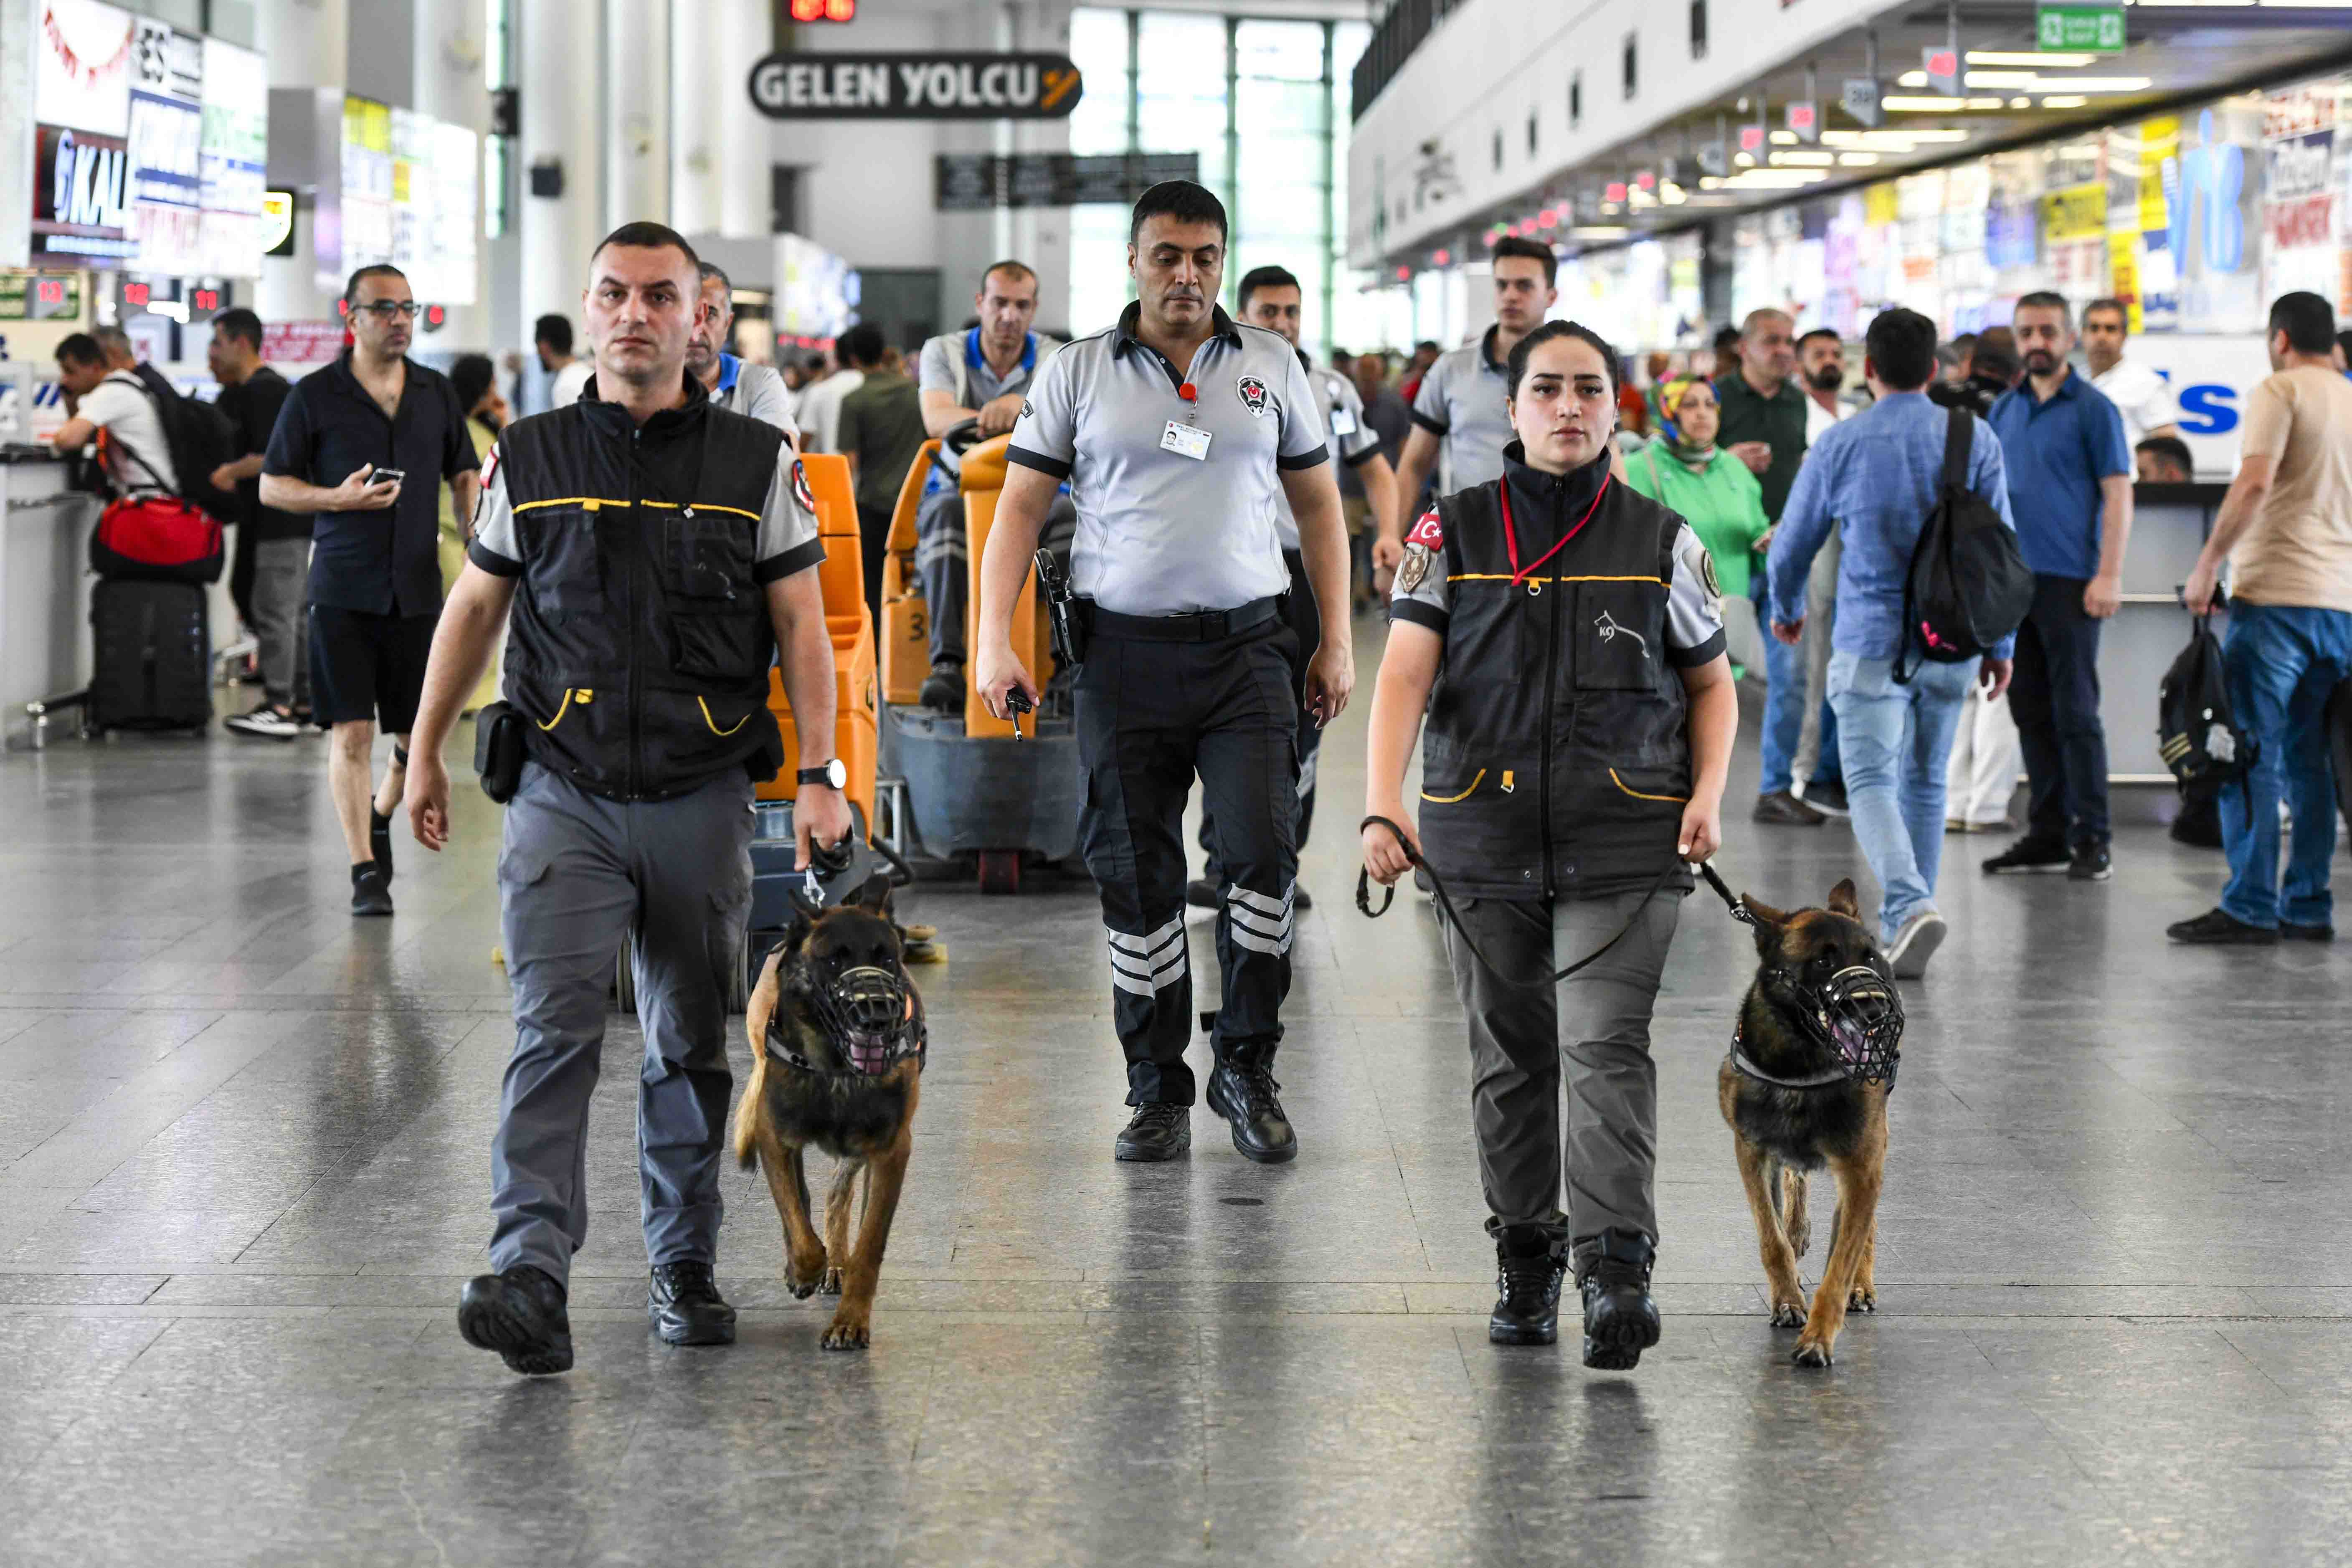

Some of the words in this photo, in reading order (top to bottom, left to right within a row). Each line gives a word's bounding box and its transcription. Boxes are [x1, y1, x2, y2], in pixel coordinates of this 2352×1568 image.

[755, 62, 890, 108] GELEN
[899, 62, 1039, 108] YOLCU
[37, 281, 63, 304] 13
[124, 283, 149, 306] 12
[195, 289, 218, 311] 11
[909, 613, 925, 641] 3
[1599, 625, 1615, 643] K9
